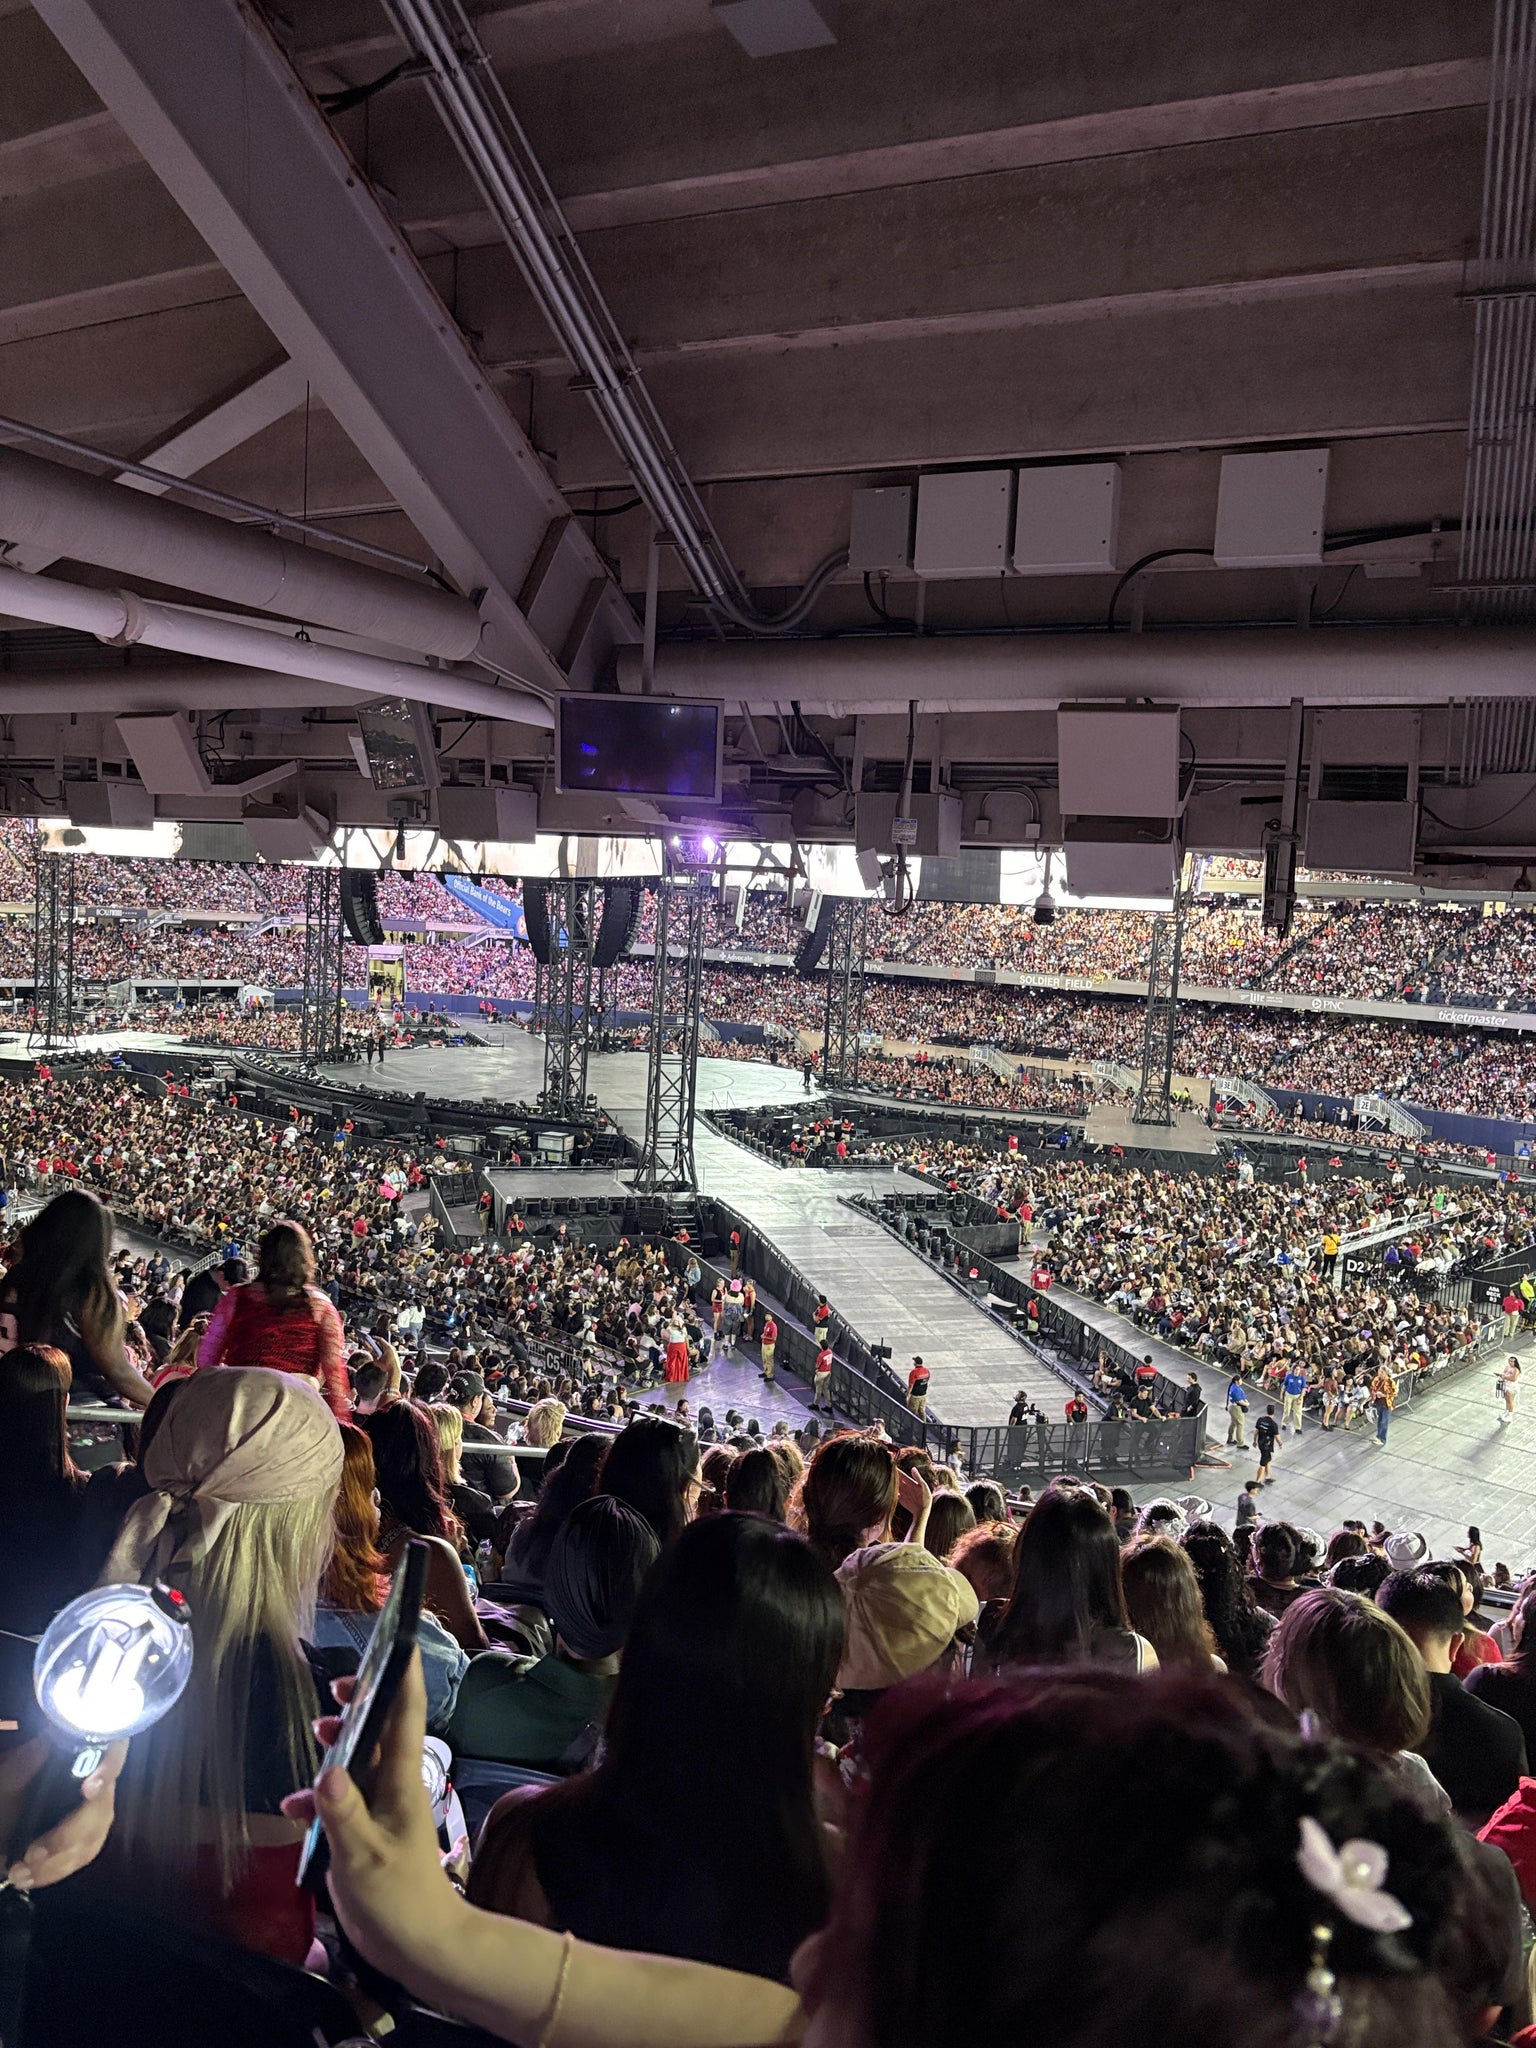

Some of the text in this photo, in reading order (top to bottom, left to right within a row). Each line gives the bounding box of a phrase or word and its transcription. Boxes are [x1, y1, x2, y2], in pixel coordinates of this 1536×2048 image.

[453, 879, 470, 894] Official
[470, 885, 482, 901] Bank
[496, 900, 511, 917] Bears
[869, 964, 885, 972] PNC
[1019, 975, 1093, 989] SOLDIER FIELD
[1323, 1000, 1345, 1010] PNC
[1438, 1010, 1508, 1026] ticketmaster
[1223, 1080, 1231, 1089] 3E
[1361, 1101, 1369, 1110] 2E
[1347, 1259, 1365, 1273] D2
[546, 1352, 560, 1371] C5
